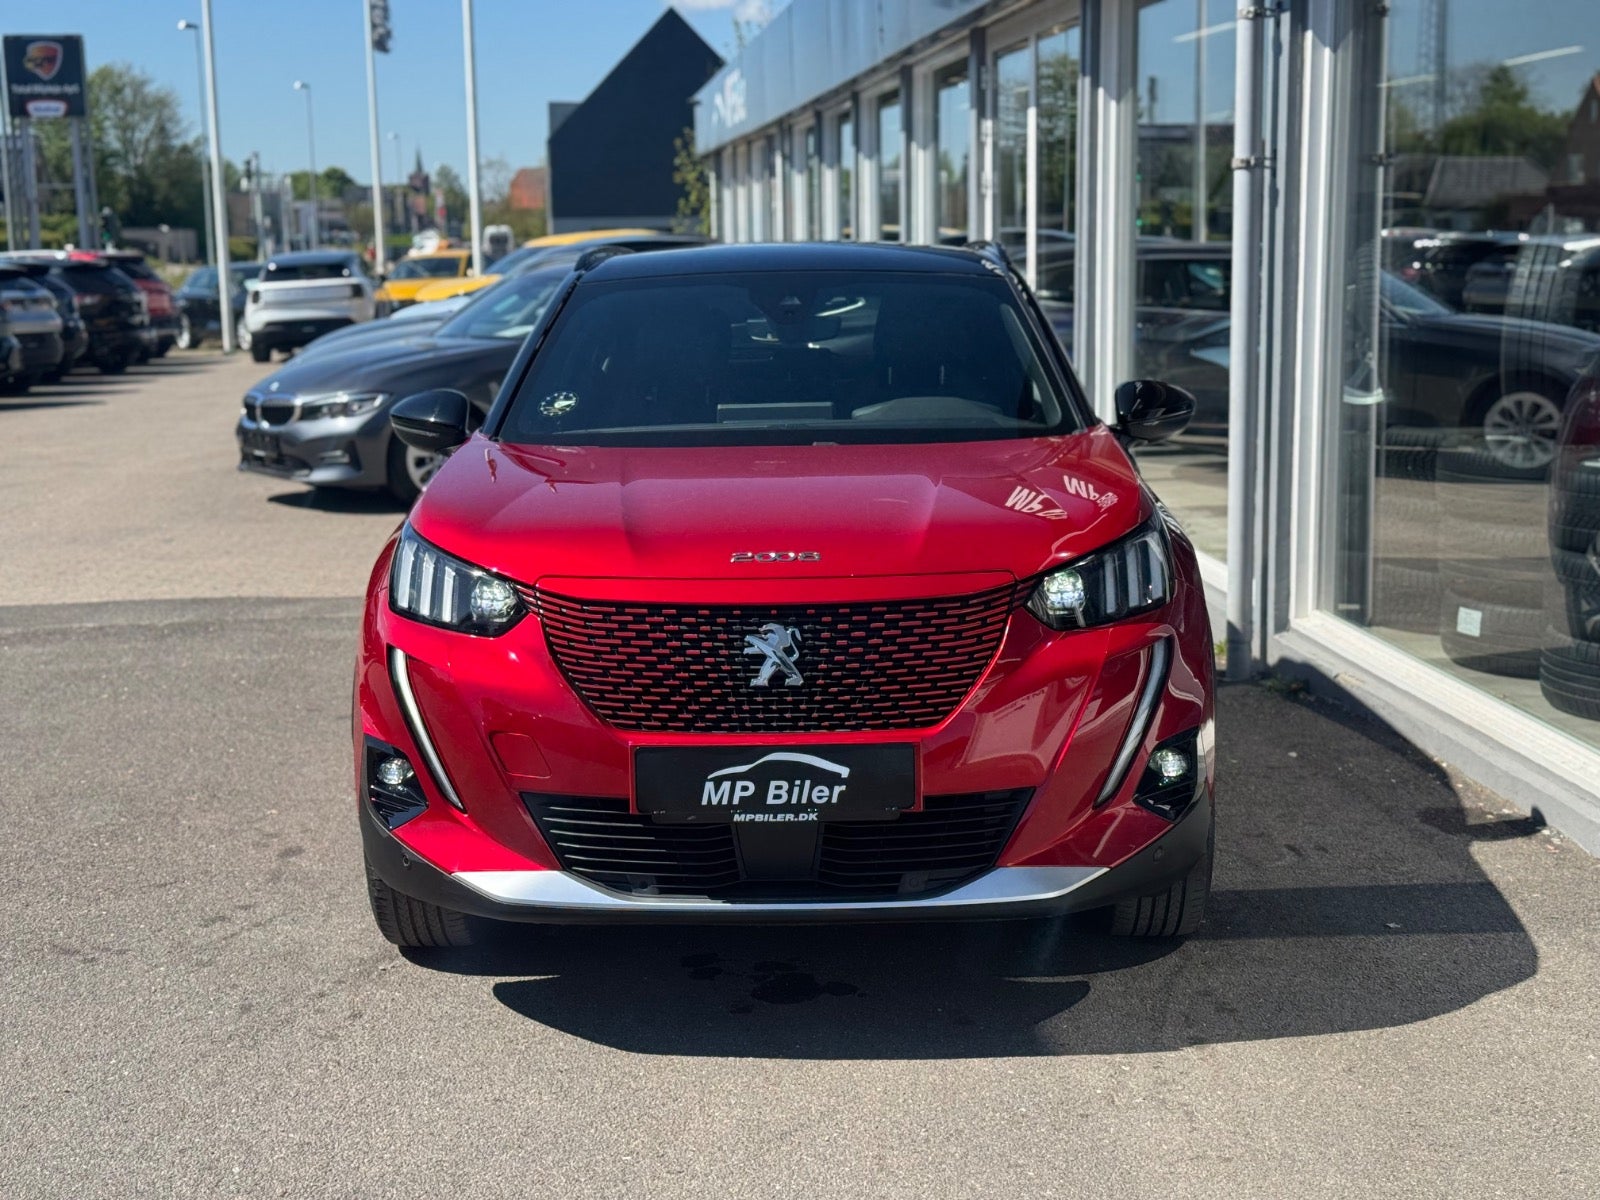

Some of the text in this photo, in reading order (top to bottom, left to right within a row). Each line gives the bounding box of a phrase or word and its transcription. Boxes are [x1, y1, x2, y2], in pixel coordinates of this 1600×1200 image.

[730, 551, 821, 563] 2008
[701, 779, 846, 806] MP Biler
[733, 812, 818, 822] MPBILER.DK
